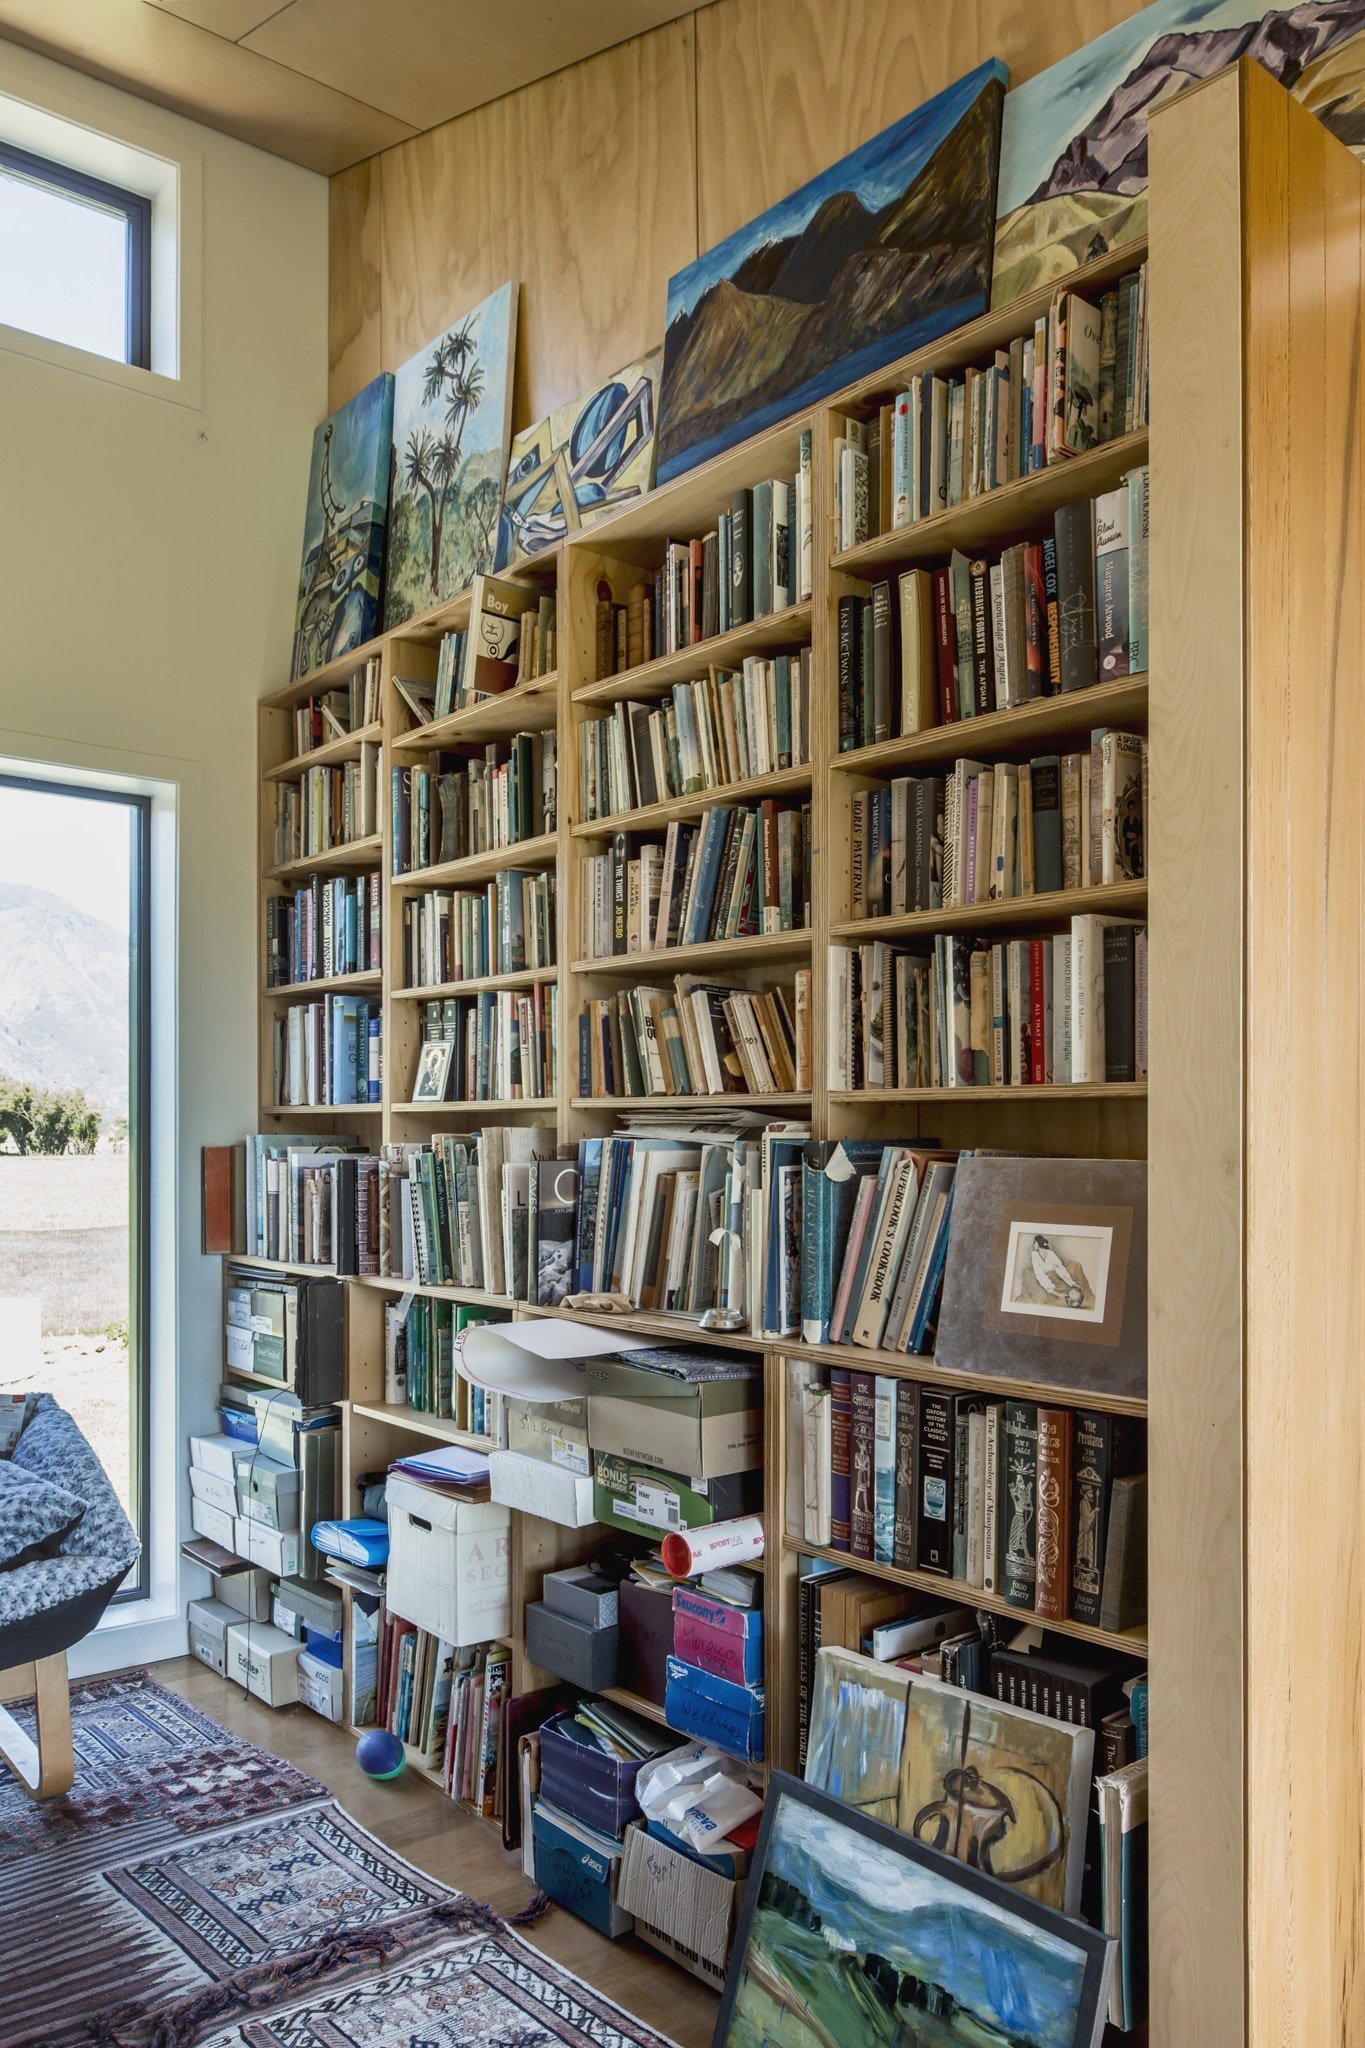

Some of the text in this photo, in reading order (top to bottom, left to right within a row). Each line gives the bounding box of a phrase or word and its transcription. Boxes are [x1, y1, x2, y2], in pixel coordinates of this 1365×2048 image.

[1096, 522, 1116, 538] Blind
[486, 594, 509, 615] Boy
[904, 582, 913, 616] YEATS
[1103, 560, 1115, 640] Margaret Atwood
[840, 607, 849, 632] IAN
[974, 577, 985, 655] FREDERICK FORSYTH
[1042, 538, 1061, 684] NIGEL COX RESPONSIBILITY
[994, 593, 1007, 685] Knowledge of Angels
[1129, 639, 1140, 668] BBC
[979, 676, 987, 707] AFGHAN
[906, 690, 914, 725] FOLIO
[1117, 735, 1122, 743] A
[1117, 743, 1142, 755] FLOWER
[872, 805, 880, 855] IMMORTALS
[915, 785, 924, 867] OLIVIA MANNING
[853, 800, 863, 905] BORIS PASTERNAK
[614, 863, 624, 915] THE THIRST JO
[1077, 982, 1084, 990] of
[1063, 941, 1072, 1061] RICHARD RUSSO Bridge of Sighs
[1035, 1039, 1041, 1047] IS
[433, 1141, 446, 1225] Animals of South America
[529, 1166, 538, 1215] CAVES
[876, 1179, 885, 1192] hay
[869, 1163, 911, 1304] SUPERCOOK'S COOKBOOK
[899, 1170, 933, 1285] The Enchanted Broccoli Forest
[891, 1296, 903, 1319] Katzen
[590, 1369, 608, 1380] KEEN
[925, 1408, 947, 1417] OXFORD
[926, 1414, 947, 1423] HISTORY
[1014, 1410, 1026, 1424] The
[519, 1413, 563, 1442] Silk Road
[923, 1426, 949, 1437] CLASSICAL
[1041, 1421, 1057, 1435] The
[1084, 1420, 1098, 1434] The
[927, 1433, 946, 1442] WORLD
[1038, 1434, 1061, 1449] Celts
[1077, 1431, 1104, 1449] Persians
[622, 1447, 664, 1466] KEENFOOTWEAR.COM
[1013, 1445, 1031, 1456] SAGGS
[1082, 1455, 1098, 1465] COOK
[597, 1464, 629, 1487] BONUS
[597, 1476, 629, 1495] PACK INSIDE
[984, 1416, 995, 1561] The Archaeology of Mesopotamia
[638, 1489, 651, 1501] Hiker
[664, 1496, 679, 1508] Brown
[648, 1507, 655, 1517] 12
[853, 1542, 870, 1553] SOCIETY
[856, 1537, 868, 1545] FOLIO
[896, 1545, 909, 1554] FOLIO
[1009, 1587, 1031, 1600] SOCIETY
[1012, 1580, 1028, 1591] FOLIO
[1039, 1591, 1057, 1603] FOLIO
[1077, 1593, 1094, 1605] FOLIO
[676, 1592, 715, 1624] Saucony
[1037, 1599, 1058, 1613] SOCIETY
[1074, 1600, 1097, 1615] SOCIETY
[238, 1652, 260, 1676] Edifier
[669, 1661, 689, 1676] Reebok
[799, 1587, 808, 1766] THE TIMES ATLAS OF THE WORLD
[1107, 1744, 1116, 1763] The
[588, 1857, 604, 1874] asics
[646, 1854, 678, 1885] Egypt
